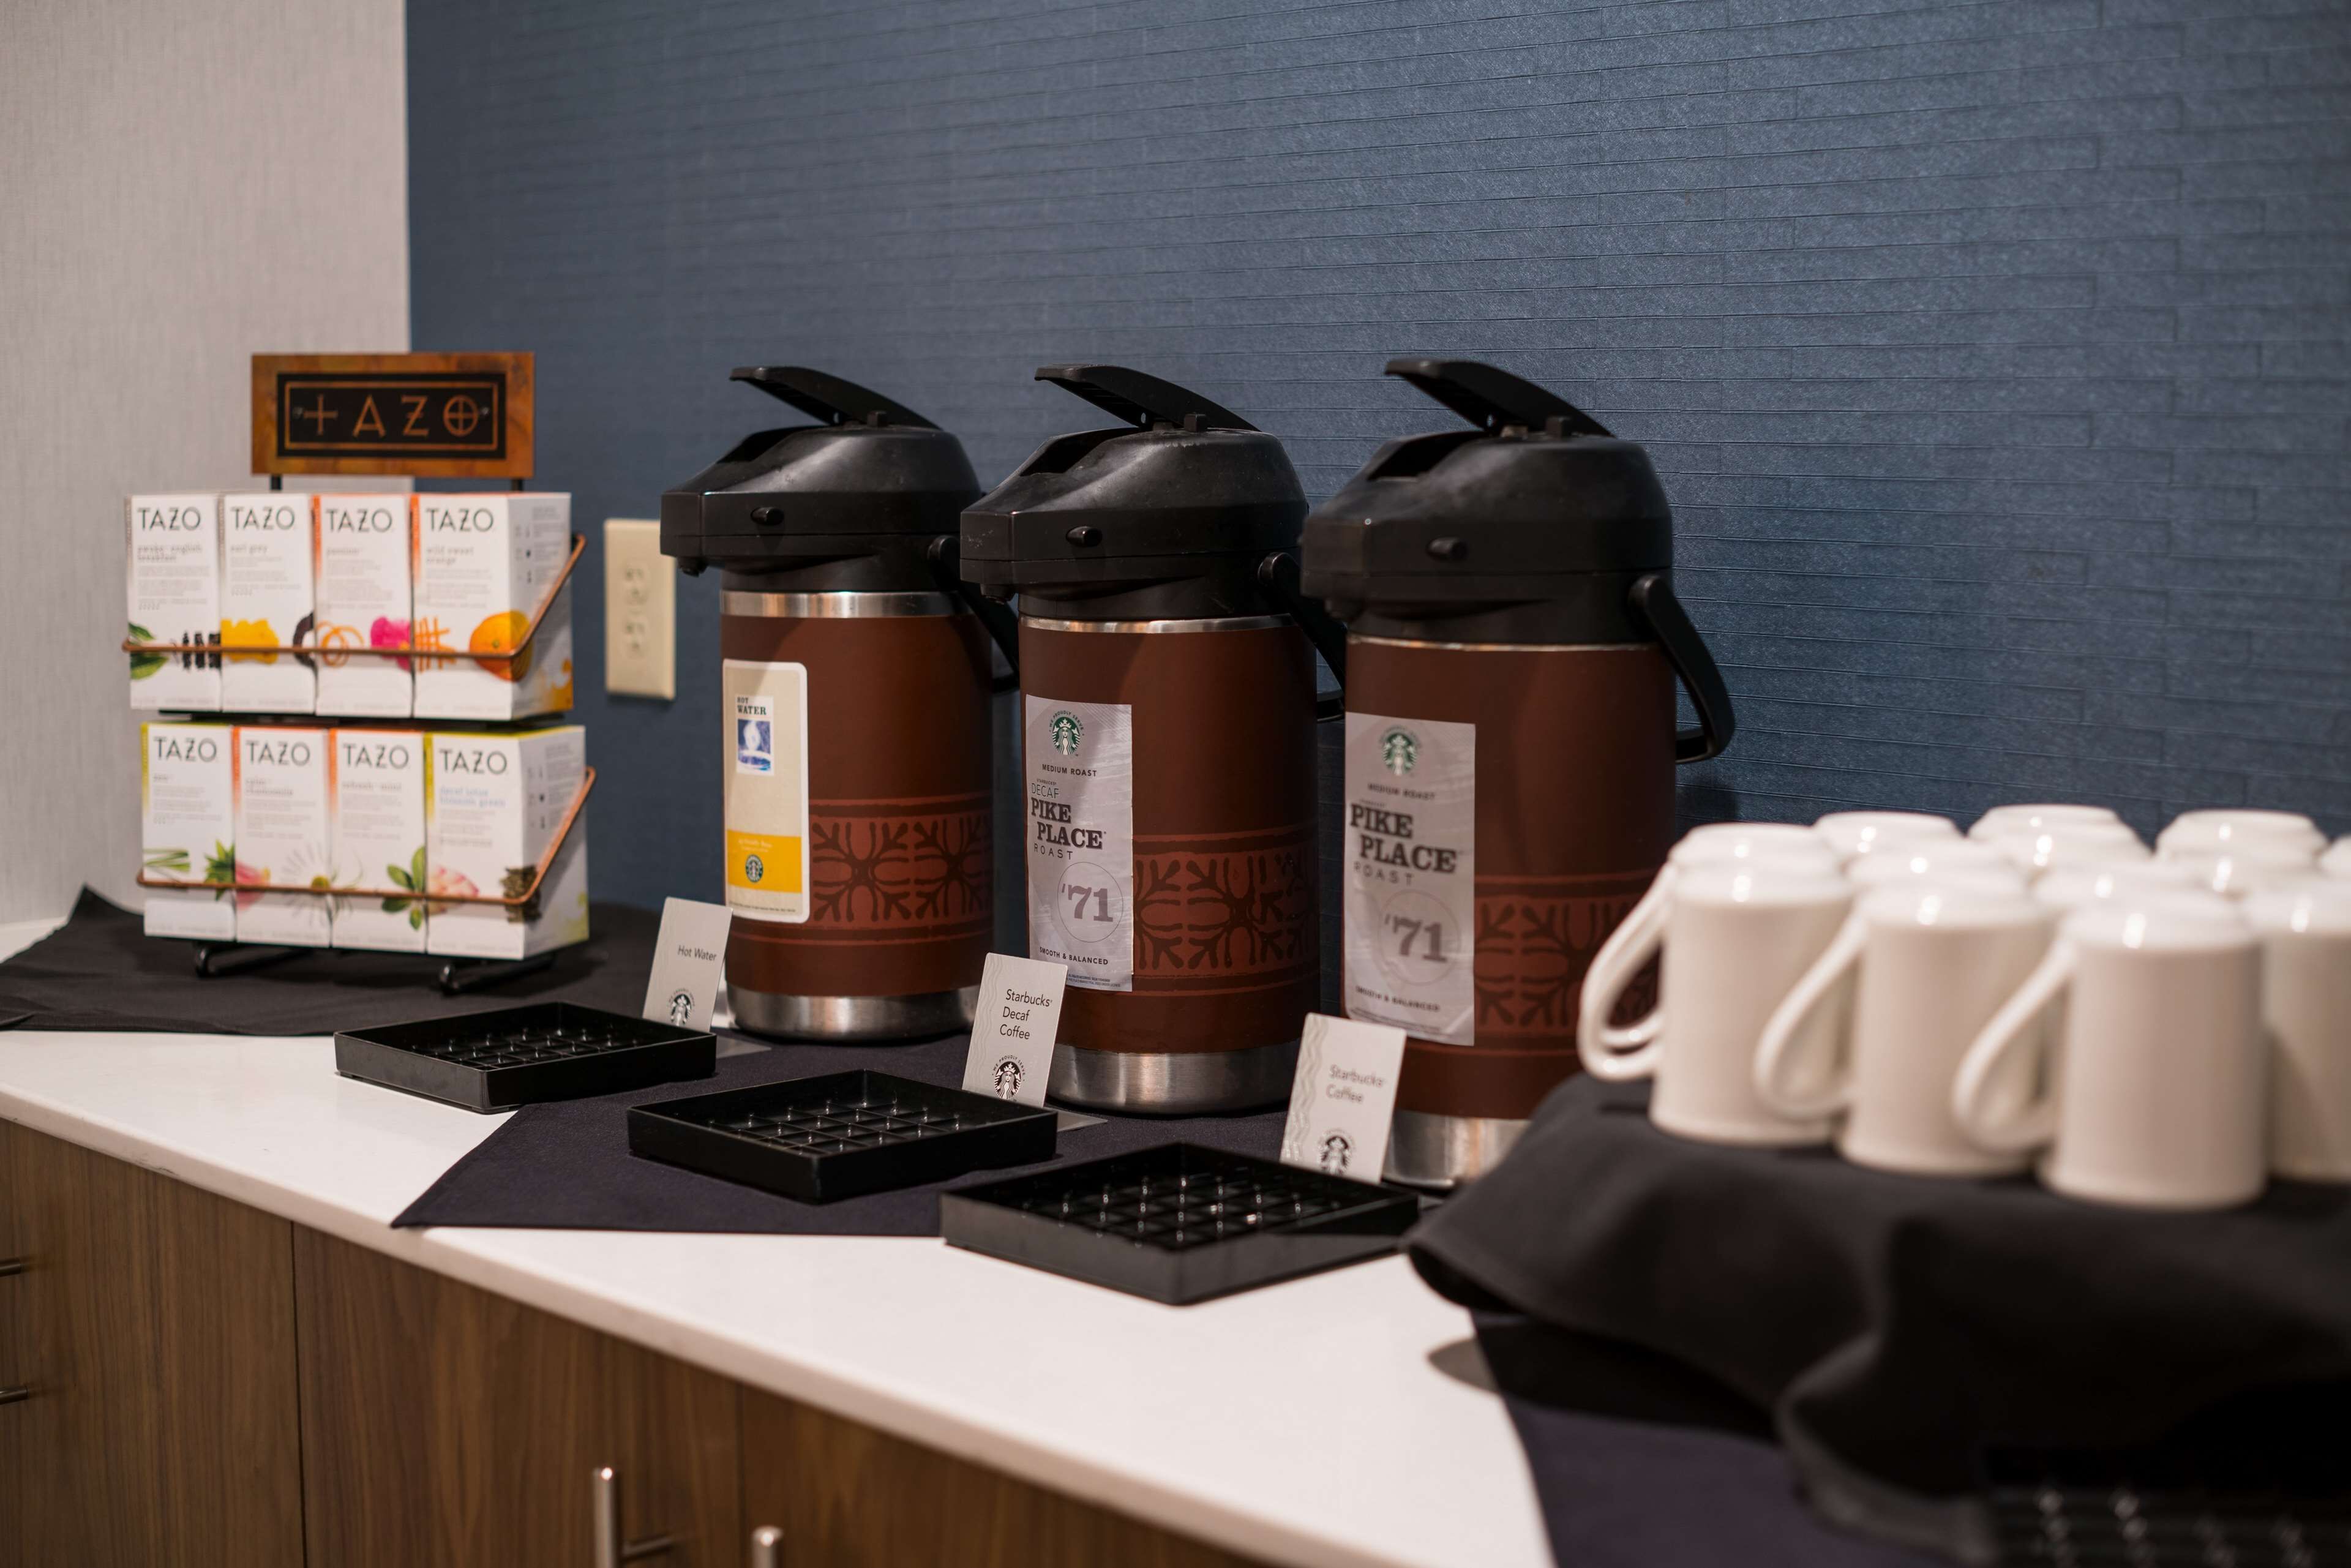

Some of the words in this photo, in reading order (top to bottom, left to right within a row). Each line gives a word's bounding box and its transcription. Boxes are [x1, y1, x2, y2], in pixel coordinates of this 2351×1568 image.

[137, 507, 201, 531] TAZO
[231, 506, 295, 531] TAZO
[326, 508, 393, 532] TAZO
[426, 508, 494, 532] TAZO
[737, 705, 767, 715] WATER
[154, 737, 217, 763] TAZO
[246, 740, 310, 766] TAZO
[343, 743, 409, 770] TAZO
[440, 748, 508, 775] TAZO
[1042, 763, 1067, 774] MEDIUM
[1071, 768, 1097, 777] ROAST
[1032, 782, 1059, 799] DECAF
[1367, 782, 1400, 795] MEDIUM
[1403, 789, 1435, 800] ROAST
[1031, 797, 1071, 823] PIKE
[1351, 803, 1412, 839] PIKE
[1037, 821, 1103, 850] PLACE
[1034, 843, 1073, 860] ROAST
[1360, 834, 1457, 874] PLACE
[1354, 861, 1413, 885] ROAST
[1062, 883, 1114, 921] '71
[1385, 914, 1447, 963] '71
[678, 945, 692, 957] Hot
[694, 948, 717, 961] Water
[1040, 947, 1060, 958] SMOOTH
[1069, 955, 1108, 965] BALANCED
[1005, 989, 1050, 1007] Starbucks
[1002, 1007, 1030, 1021] Decaf
[1000, 1024, 1030, 1040] Coffee
[1326, 1084, 1363, 1103] Coffee
